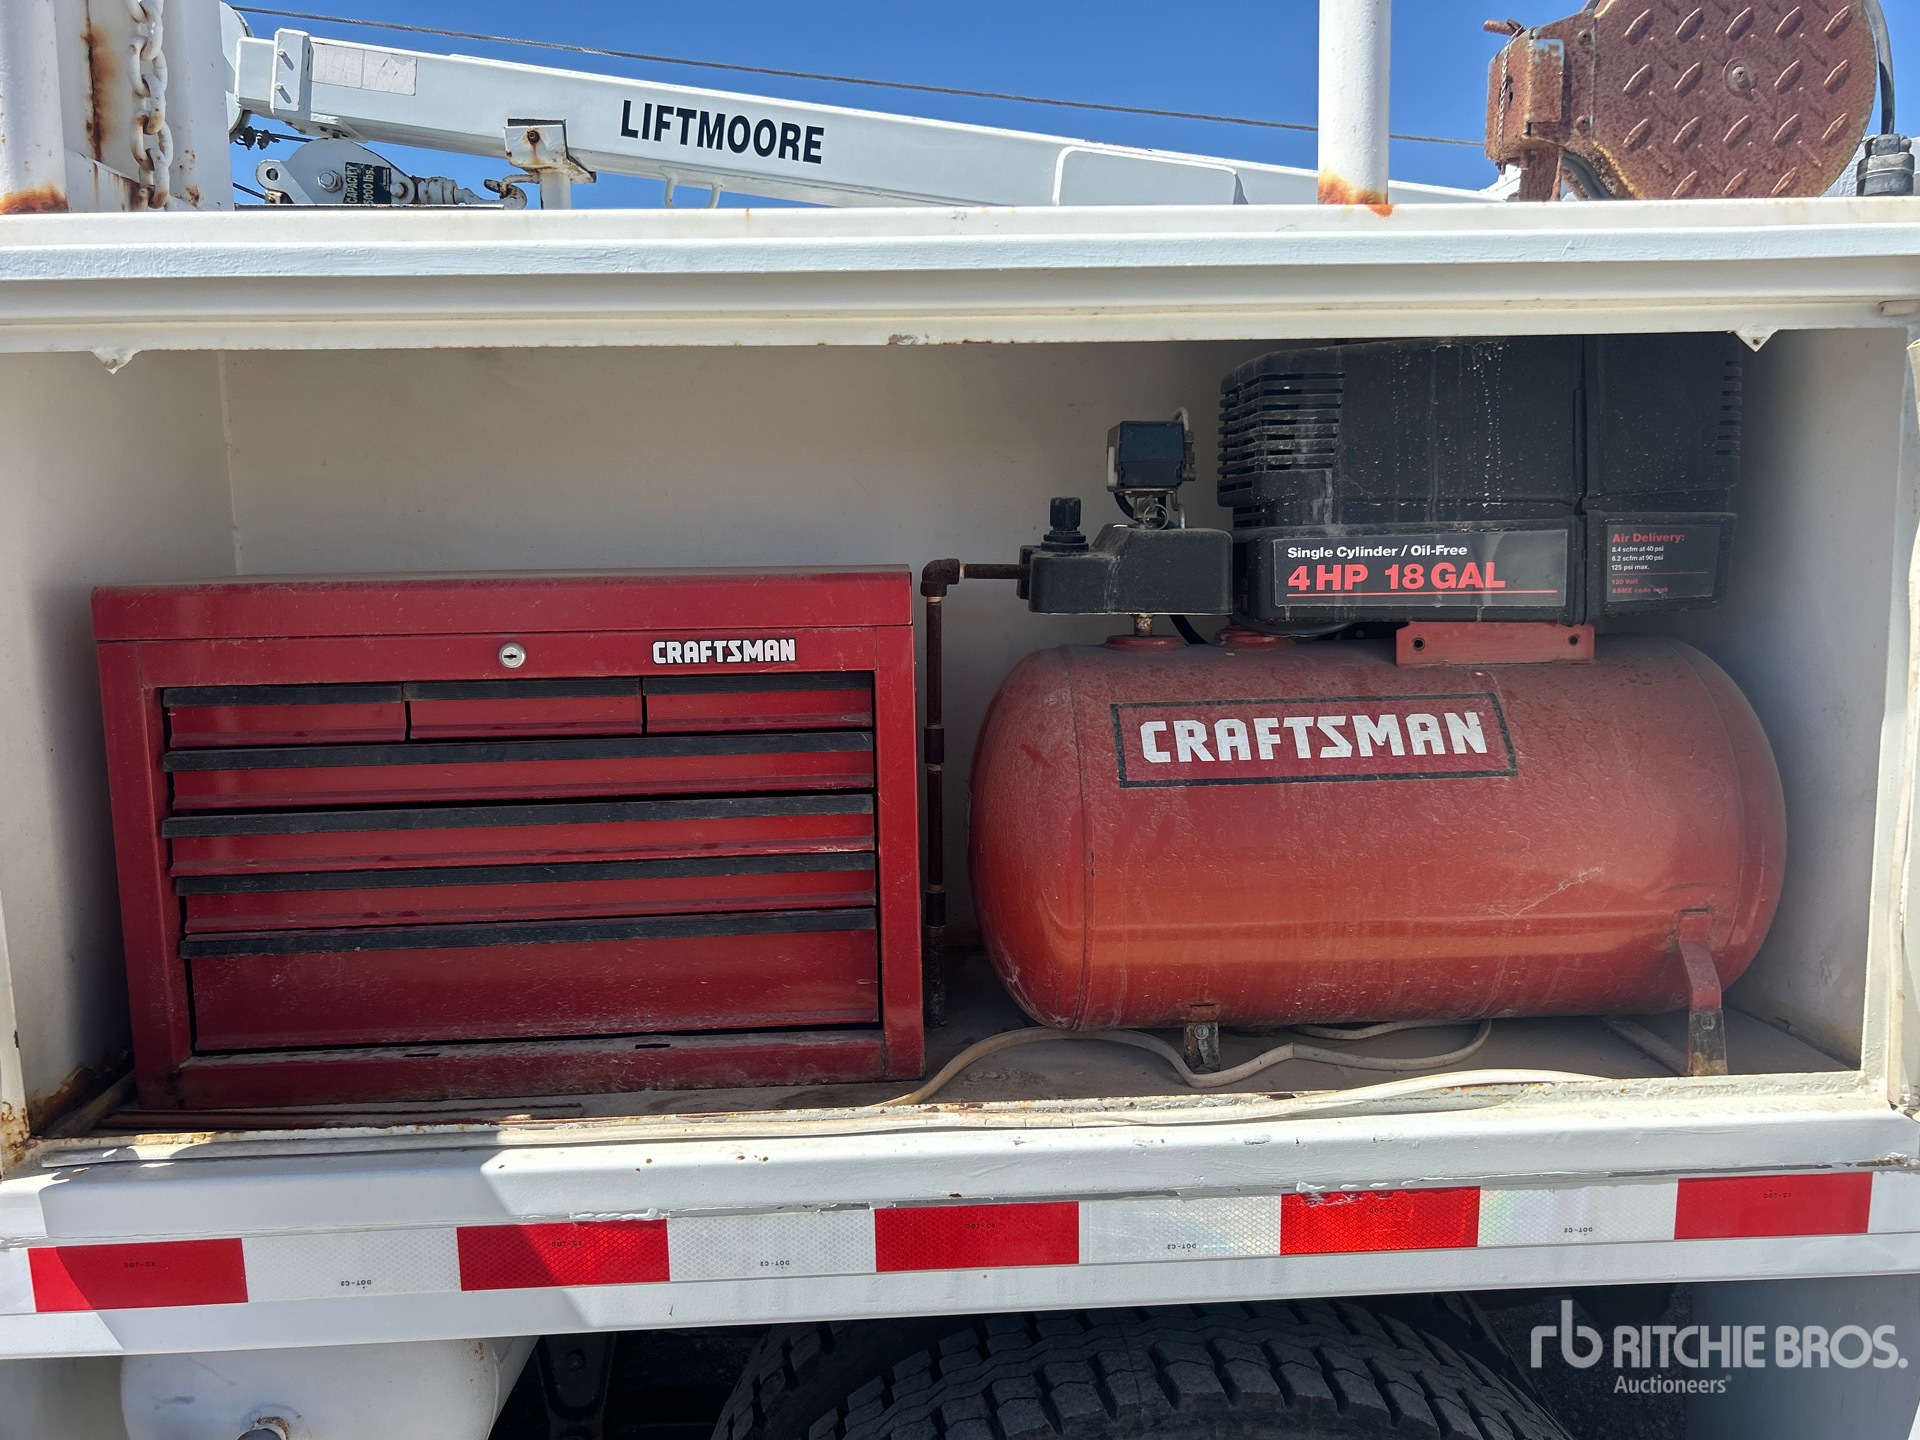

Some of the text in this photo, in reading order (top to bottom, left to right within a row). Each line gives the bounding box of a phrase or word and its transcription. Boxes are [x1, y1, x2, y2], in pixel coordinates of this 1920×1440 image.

[620, 99, 825, 165] LIFTMOORE
[346, 163, 358, 204] CAPACITY
[1611, 532, 1685, 544] Air Delivery:
[1287, 546, 1333, 560] Single
[1336, 545, 1399, 560] Cylinder
[1410, 544, 1468, 557] Oil-Free
[1430, 562, 1506, 589] GAL
[1623, 564, 1634, 572] psi
[652, 638, 796, 664] CRAFTSMAN
[1139, 712, 1488, 764] CRAFTSMAN
